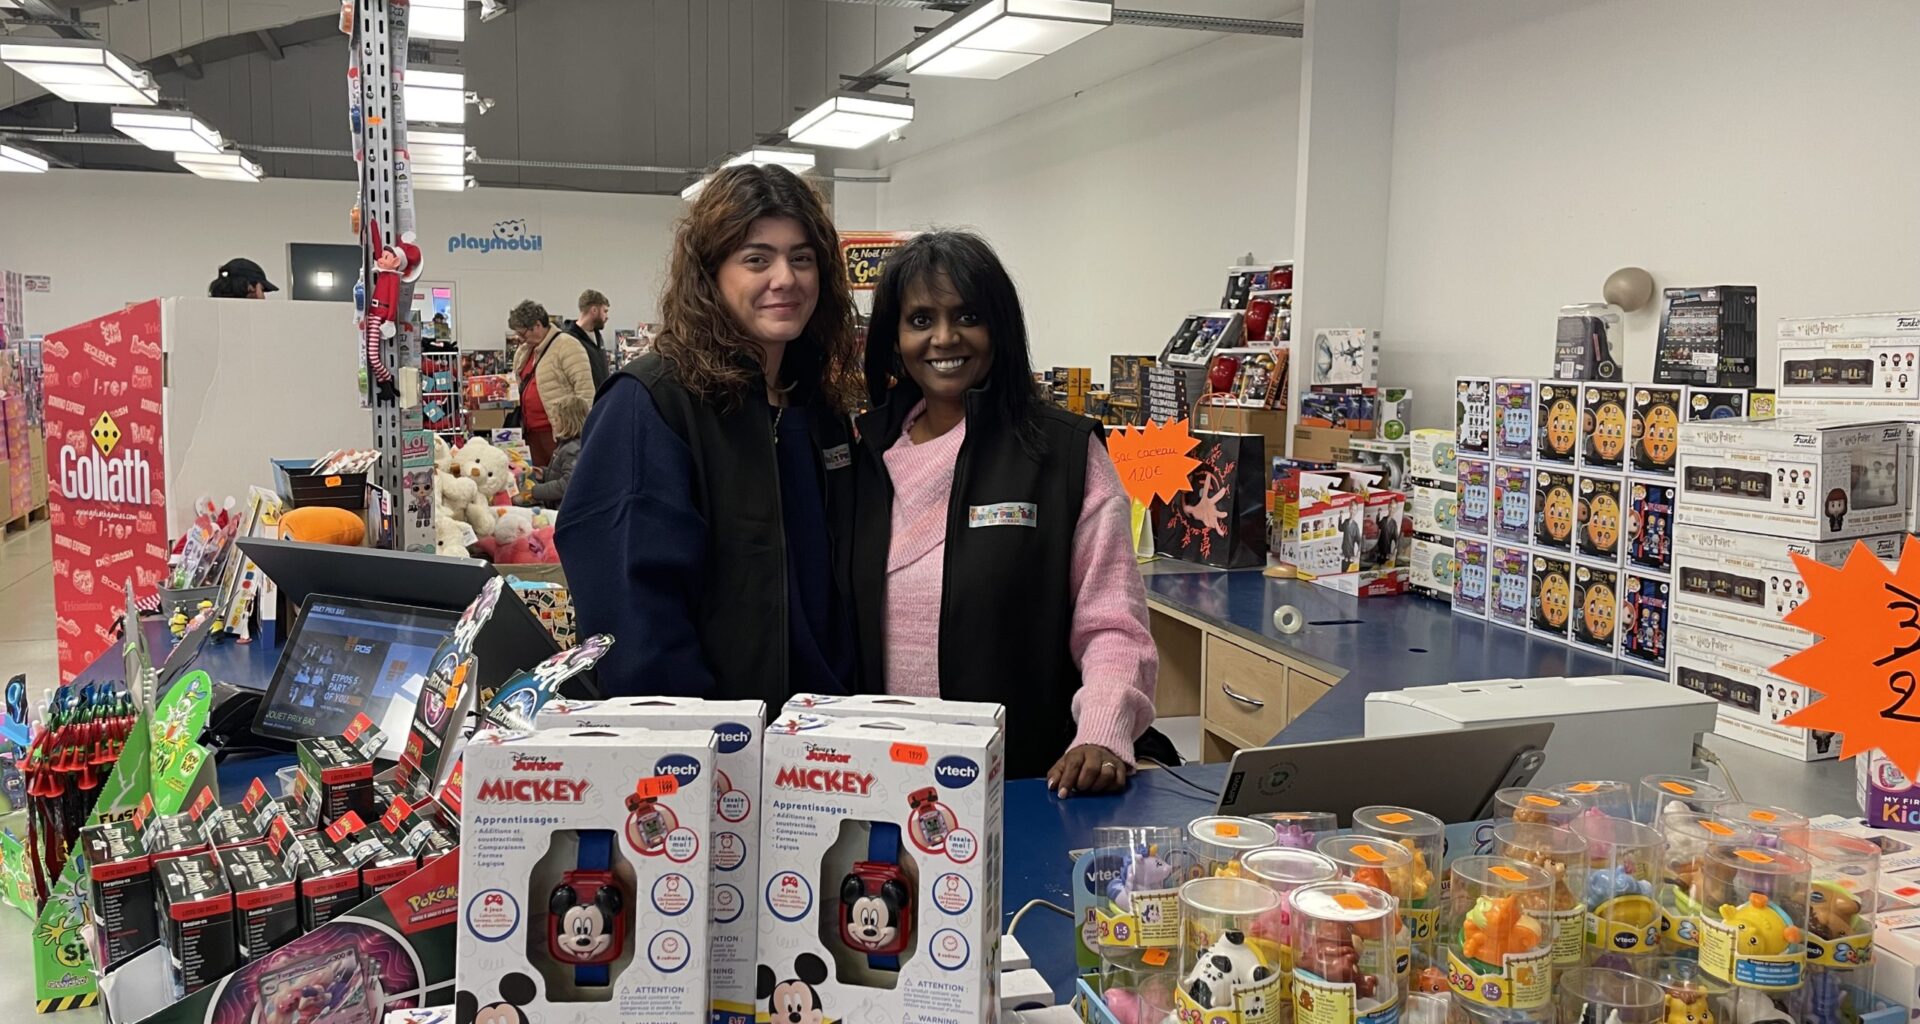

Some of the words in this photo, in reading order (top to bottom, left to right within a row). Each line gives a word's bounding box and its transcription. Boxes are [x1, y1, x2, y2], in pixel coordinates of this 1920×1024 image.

[448, 233, 543, 253] playmobil
[849, 249, 861, 261] Le
[861, 249, 879, 259] Noël
[1896, 317, 1920, 328] Funko
[403, 436, 428, 450] LOL
[1793, 433, 1817, 445] Funko
[60, 445, 151, 505] Goliath
[328, 682, 347, 693] PART
[323, 691, 334, 701] OF
[302, 715, 317, 727] BAS
[802, 741, 832, 753] Disney
[509, 751, 540, 762] Disney
[656, 763, 698, 776] vtech
[936, 764, 977, 779] vtech
[774, 765, 876, 796] MICKEY
[476, 777, 591, 805] MICKEY
[773, 800, 847, 815] Apprentissages
[474, 815, 559, 826] Apprentissages
[776, 812, 806, 820] Additions
[775, 821, 816, 829] soustractions
[776, 828, 818, 837] Comparaisons
[775, 835, 798, 843] Formes
[775, 843, 800, 851] Logique
[1115, 925, 1128, 934] 1-5
[635, 986, 685, 994] ATTENTION
[918, 980, 965, 993] ATTENTION
[1485, 984, 1499, 994] 1-5
